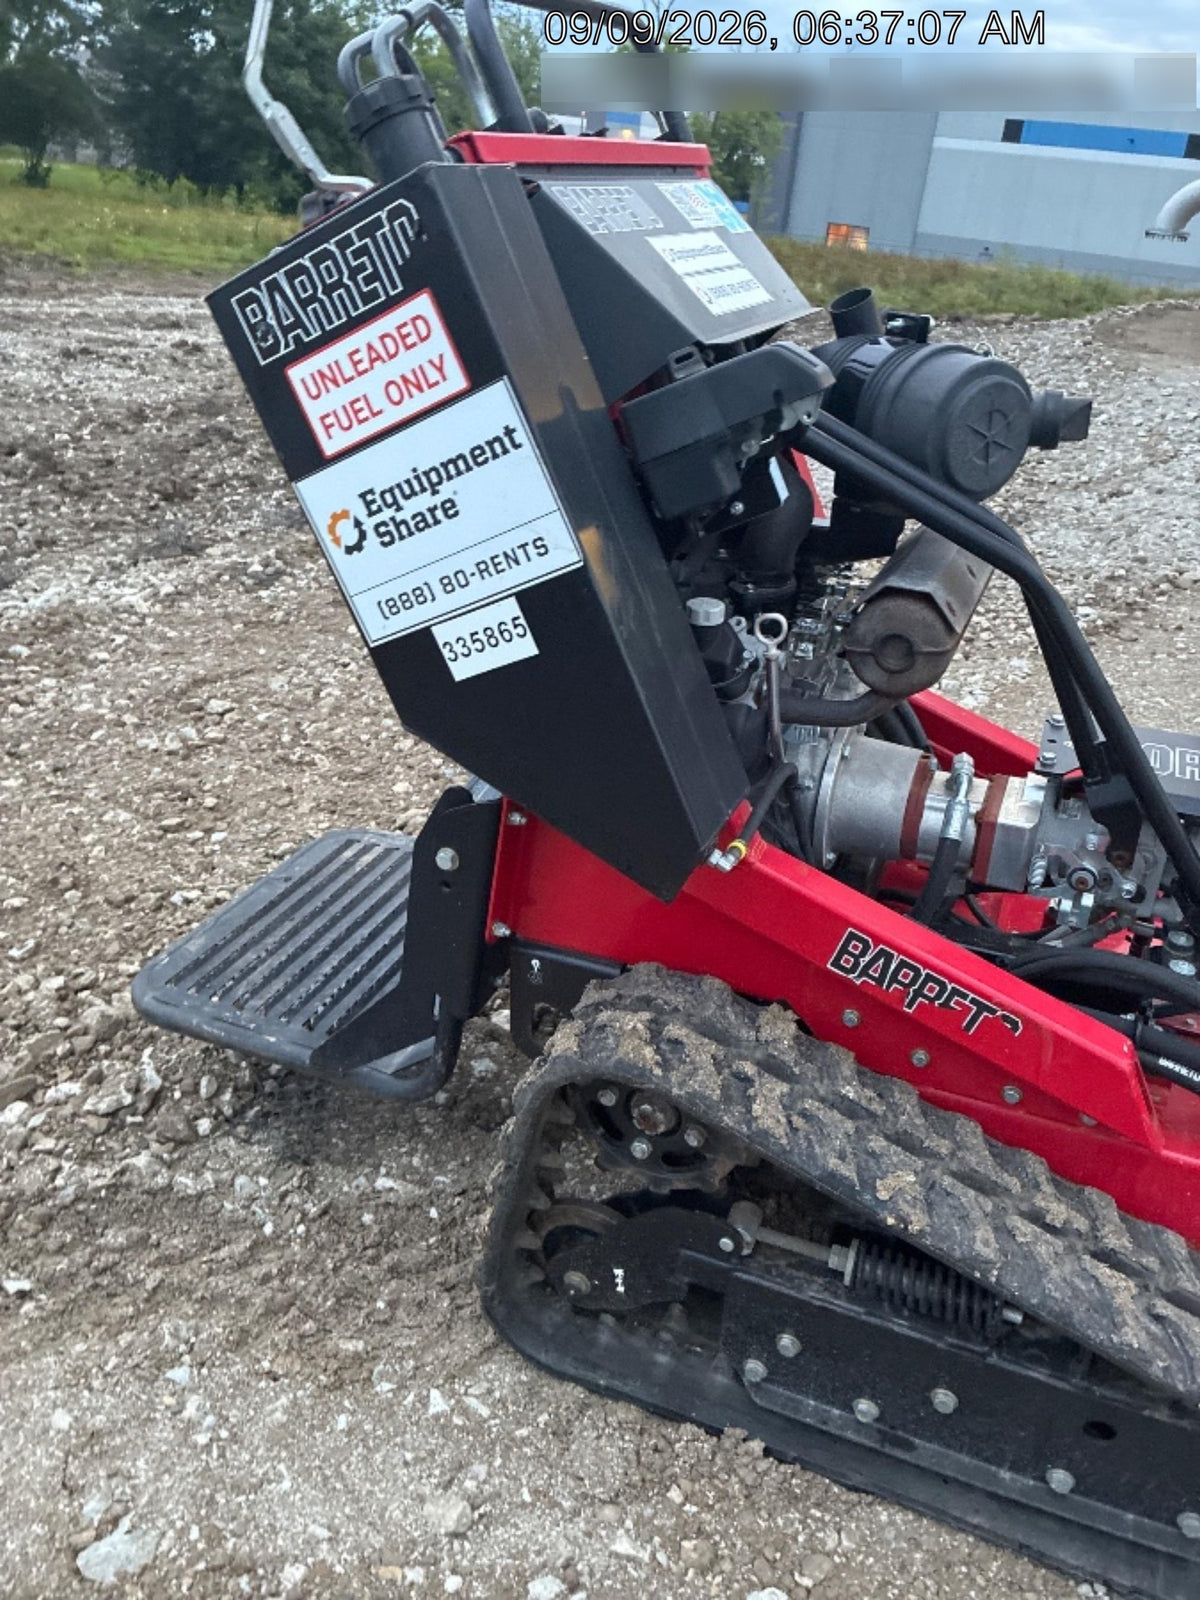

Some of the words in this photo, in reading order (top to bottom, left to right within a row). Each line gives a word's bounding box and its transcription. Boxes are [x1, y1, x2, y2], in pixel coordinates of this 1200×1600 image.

[300, 314, 432, 401] UNLEADED
[319, 394, 383, 440] FUEL
[384, 353, 448, 406] ONLY
[358, 424, 523, 518] Equipment
[373, 497, 460, 548] Share
[377, 582, 436, 620] (888)
[439, 536, 549, 595] 80-RENTS
[442, 615, 528, 662] 335865
